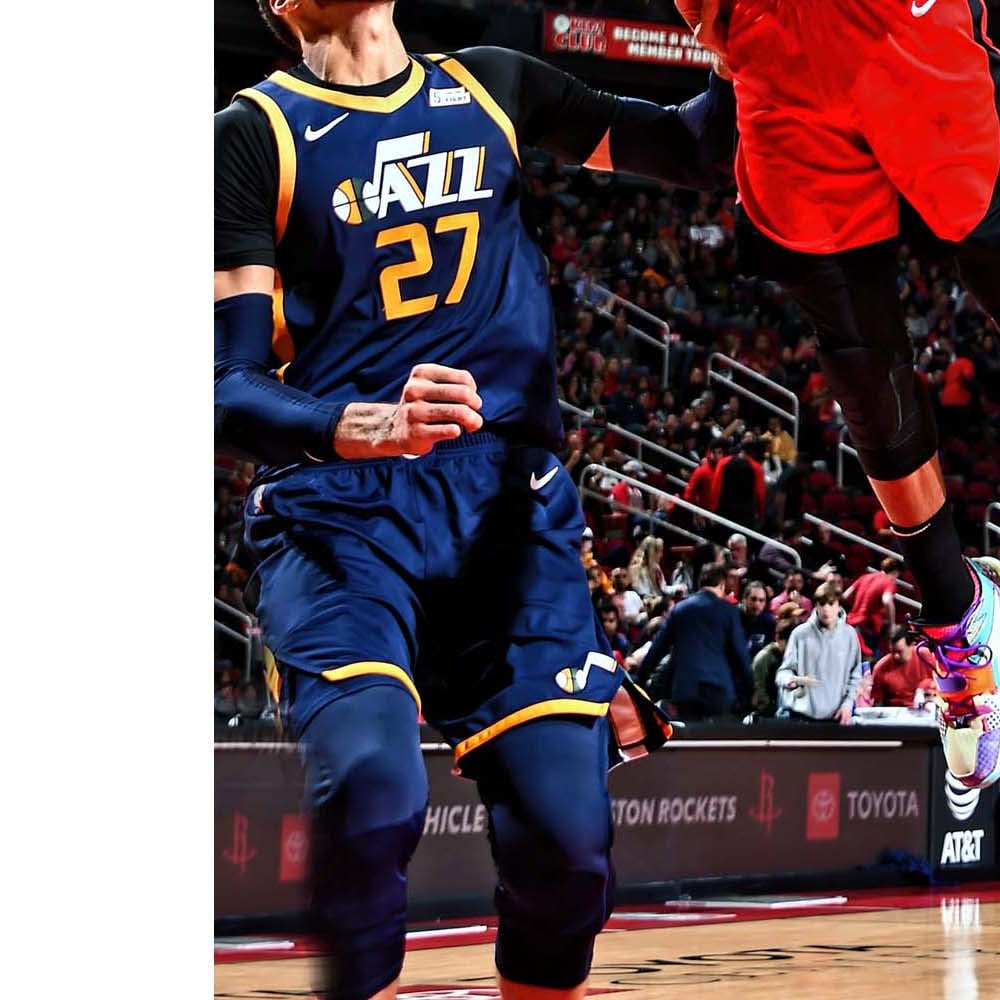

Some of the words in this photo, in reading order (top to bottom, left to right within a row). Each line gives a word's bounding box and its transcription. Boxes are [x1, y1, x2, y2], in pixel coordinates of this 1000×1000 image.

[613, 26, 667, 43] BECOME
[627, 43, 683, 61] MEMBER
[361, 130, 493, 220] JAZZ
[375, 211, 480, 321] 27
[657, 795, 738, 824] ROCKETS
[847, 790, 920, 821] TOYOTA
[940, 829, 985, 865] AT&T
